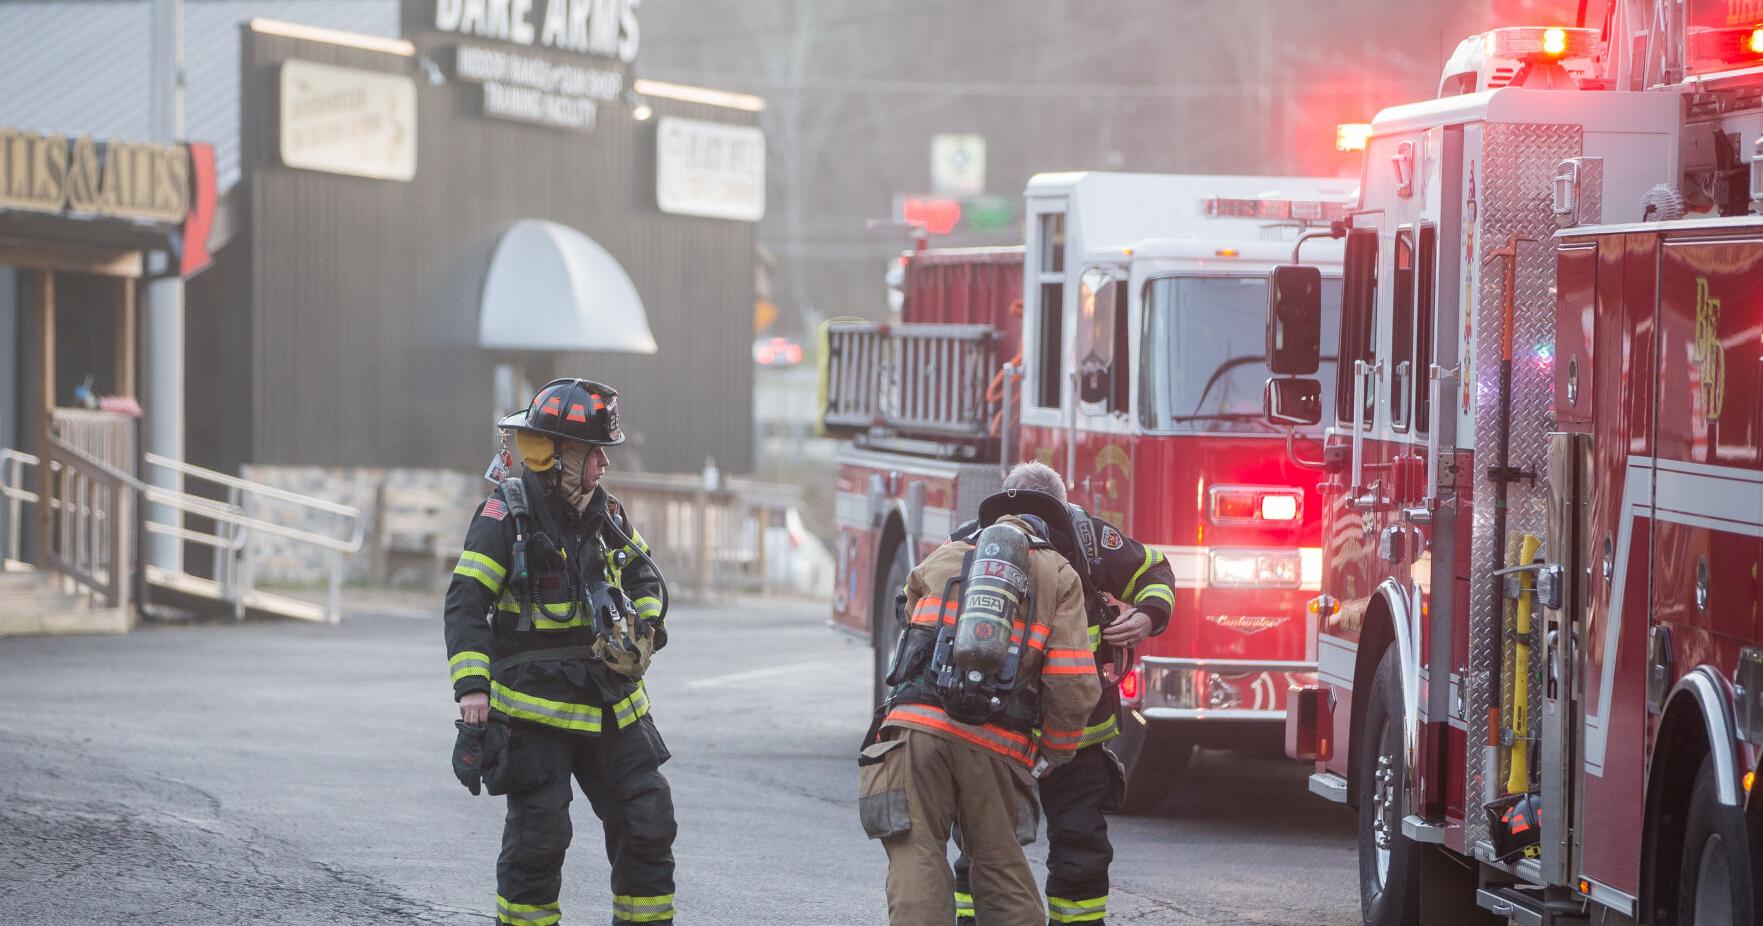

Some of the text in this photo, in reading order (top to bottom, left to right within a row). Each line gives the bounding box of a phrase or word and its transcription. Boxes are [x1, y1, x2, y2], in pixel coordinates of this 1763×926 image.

[541, 0, 640, 63] ARMS
[1077, 520, 1095, 557] MSA
[984, 559, 1006, 578] L2
[969, 595, 1002, 611] MSA
